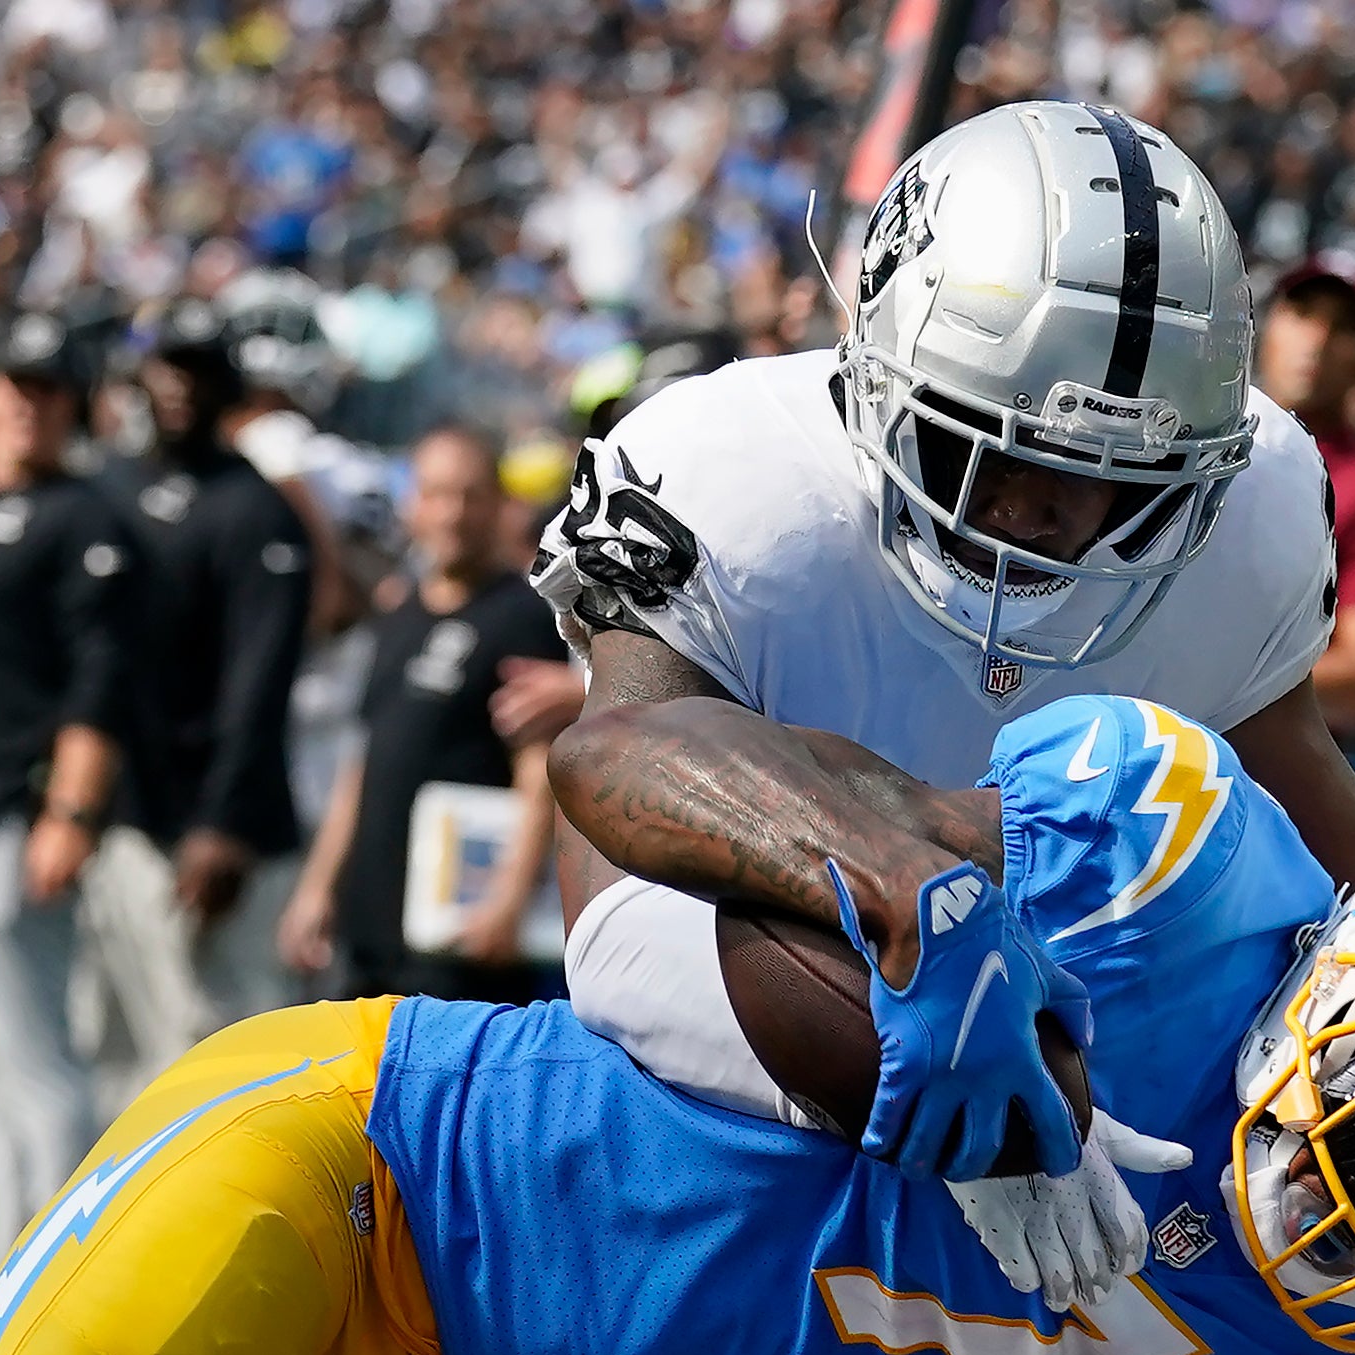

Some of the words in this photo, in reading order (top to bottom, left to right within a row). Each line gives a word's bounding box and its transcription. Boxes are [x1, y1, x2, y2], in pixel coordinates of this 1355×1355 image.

[1082, 396, 1143, 419] RAIDERS
[989, 667, 1019, 691] NFL
[1159, 1221, 1194, 1261] NFL
